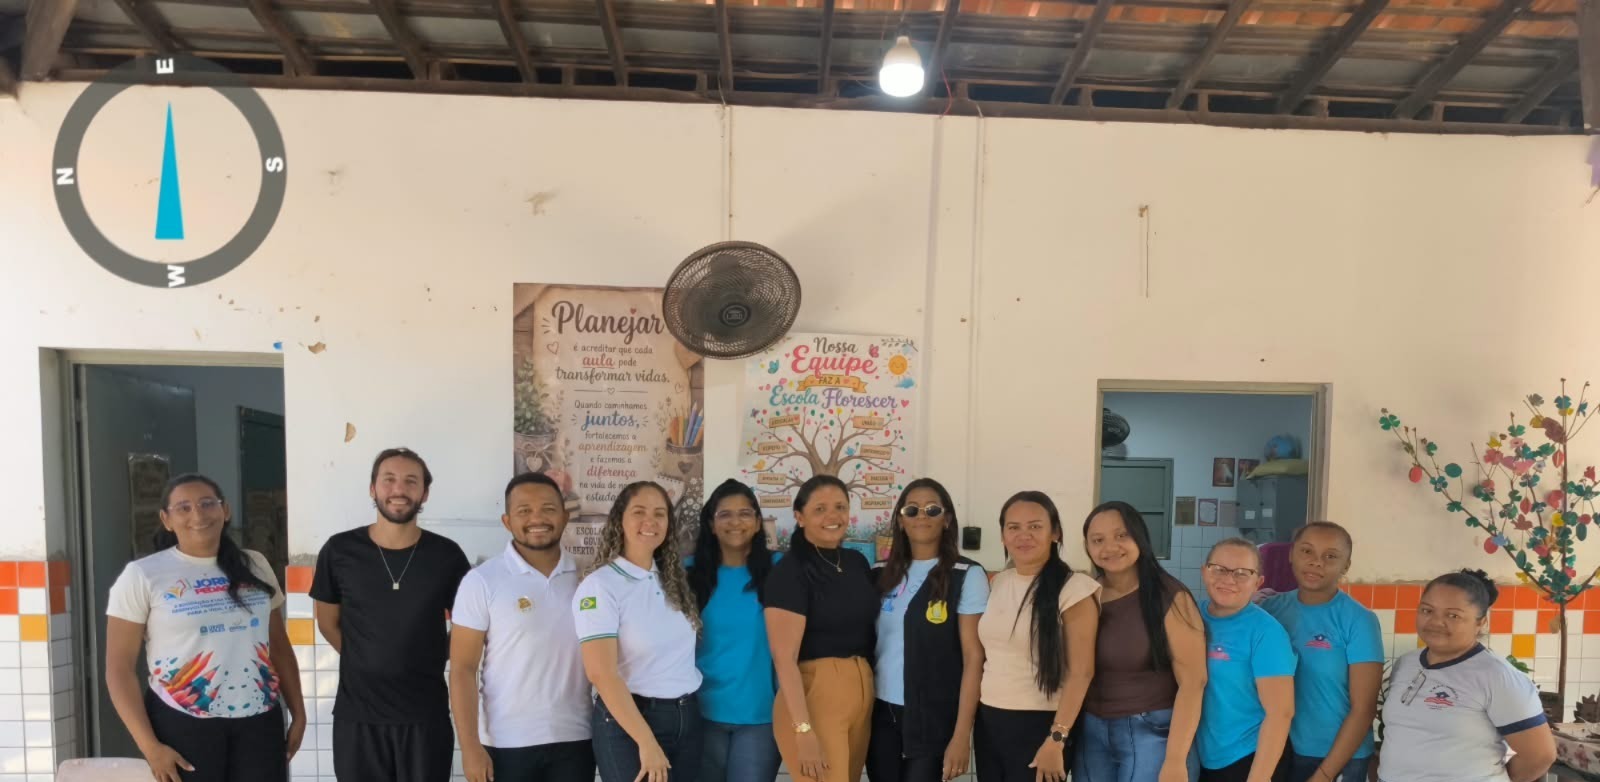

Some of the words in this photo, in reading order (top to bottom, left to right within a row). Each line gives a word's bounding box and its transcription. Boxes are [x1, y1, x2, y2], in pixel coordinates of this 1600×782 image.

[551, 300, 664, 345] Planejar
[581, 344, 616, 353] acreditar
[618, 347, 632, 355] que
[634, 346, 653, 354] cada
[814, 337, 858, 354] Nossa
[582, 353, 615, 366] aula
[618, 358, 637, 368] pode
[791, 344, 878, 379] Equipe
[556, 366, 631, 384] transformar
[635, 368, 670, 383] vidas.
[818, 376, 833, 384] FAZ
[834, 376, 841, 384] A
[769, 385, 819, 406] Escola
[821, 387, 897, 408] Florescer
[574, 400, 602, 409] Quando
[604, 401, 648, 410] caminhamos
[581, 410, 640, 431] juntos,
[585, 430, 630, 440] fortalecemos
[578, 441, 647, 454] aprendizagem
[597, 454, 625, 464] fazemos
[586, 465, 638, 480] diferença
[590, 481, 605, 489] vida
[607, 480, 616, 489] de
